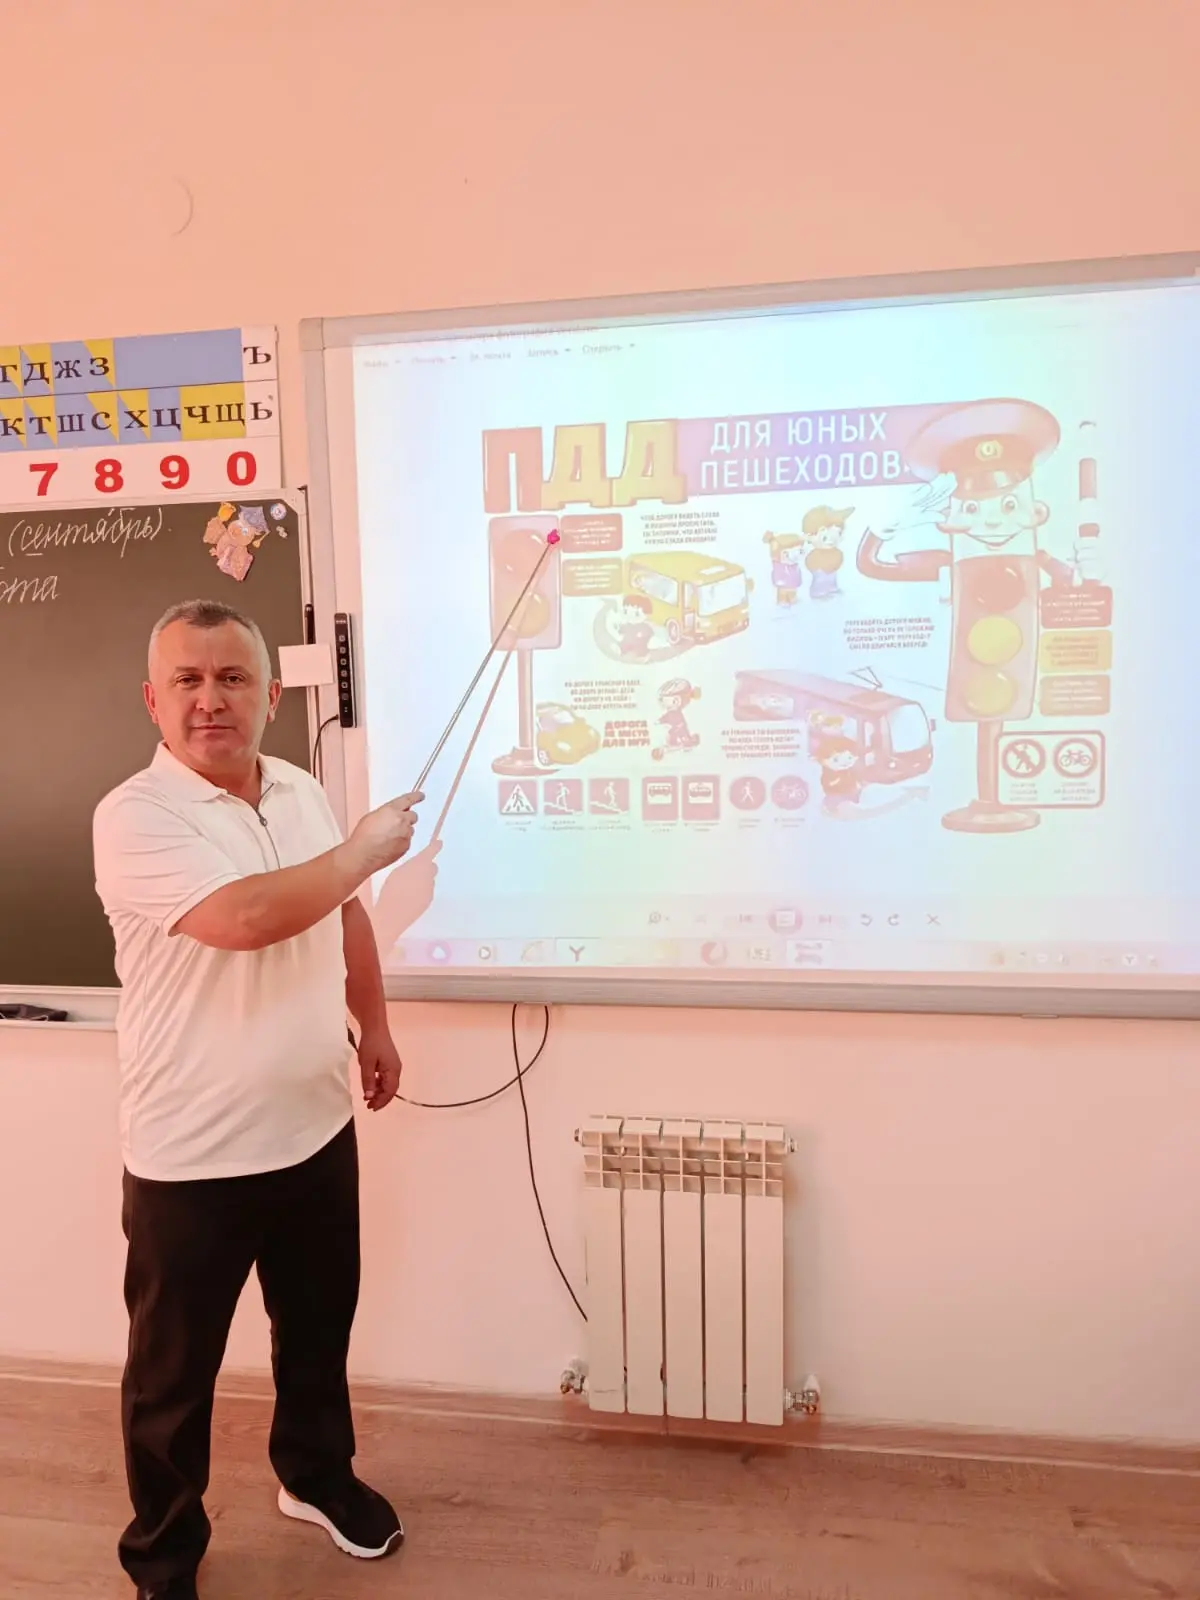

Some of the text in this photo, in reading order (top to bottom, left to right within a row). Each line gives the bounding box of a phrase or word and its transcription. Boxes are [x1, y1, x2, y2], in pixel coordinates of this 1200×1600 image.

[710, 412, 888, 455] ДЛЯ ЮНЫХ
[29, 451, 257, 497] 7 8 9 0
[482, 418, 688, 514] ПДД
